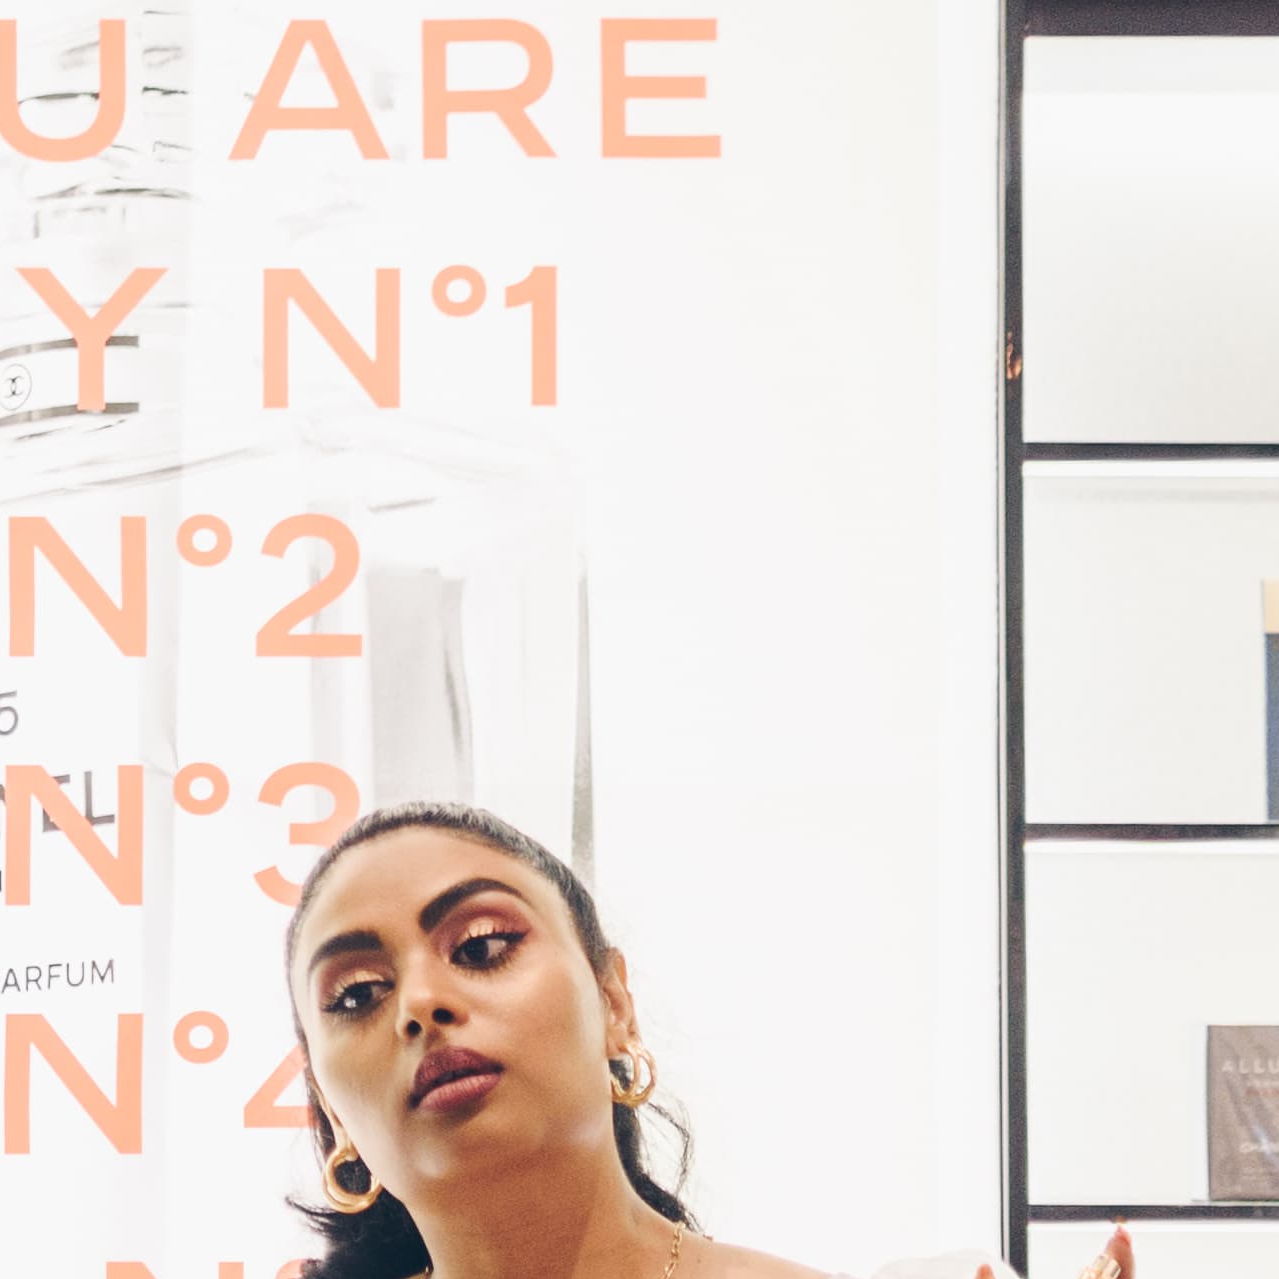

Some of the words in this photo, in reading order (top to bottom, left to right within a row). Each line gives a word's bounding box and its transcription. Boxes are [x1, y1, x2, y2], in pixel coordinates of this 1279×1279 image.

[229, 17, 721, 160] ARE
[263, 265, 557, 408] N°1
[8, 513, 362, 658] N°2
